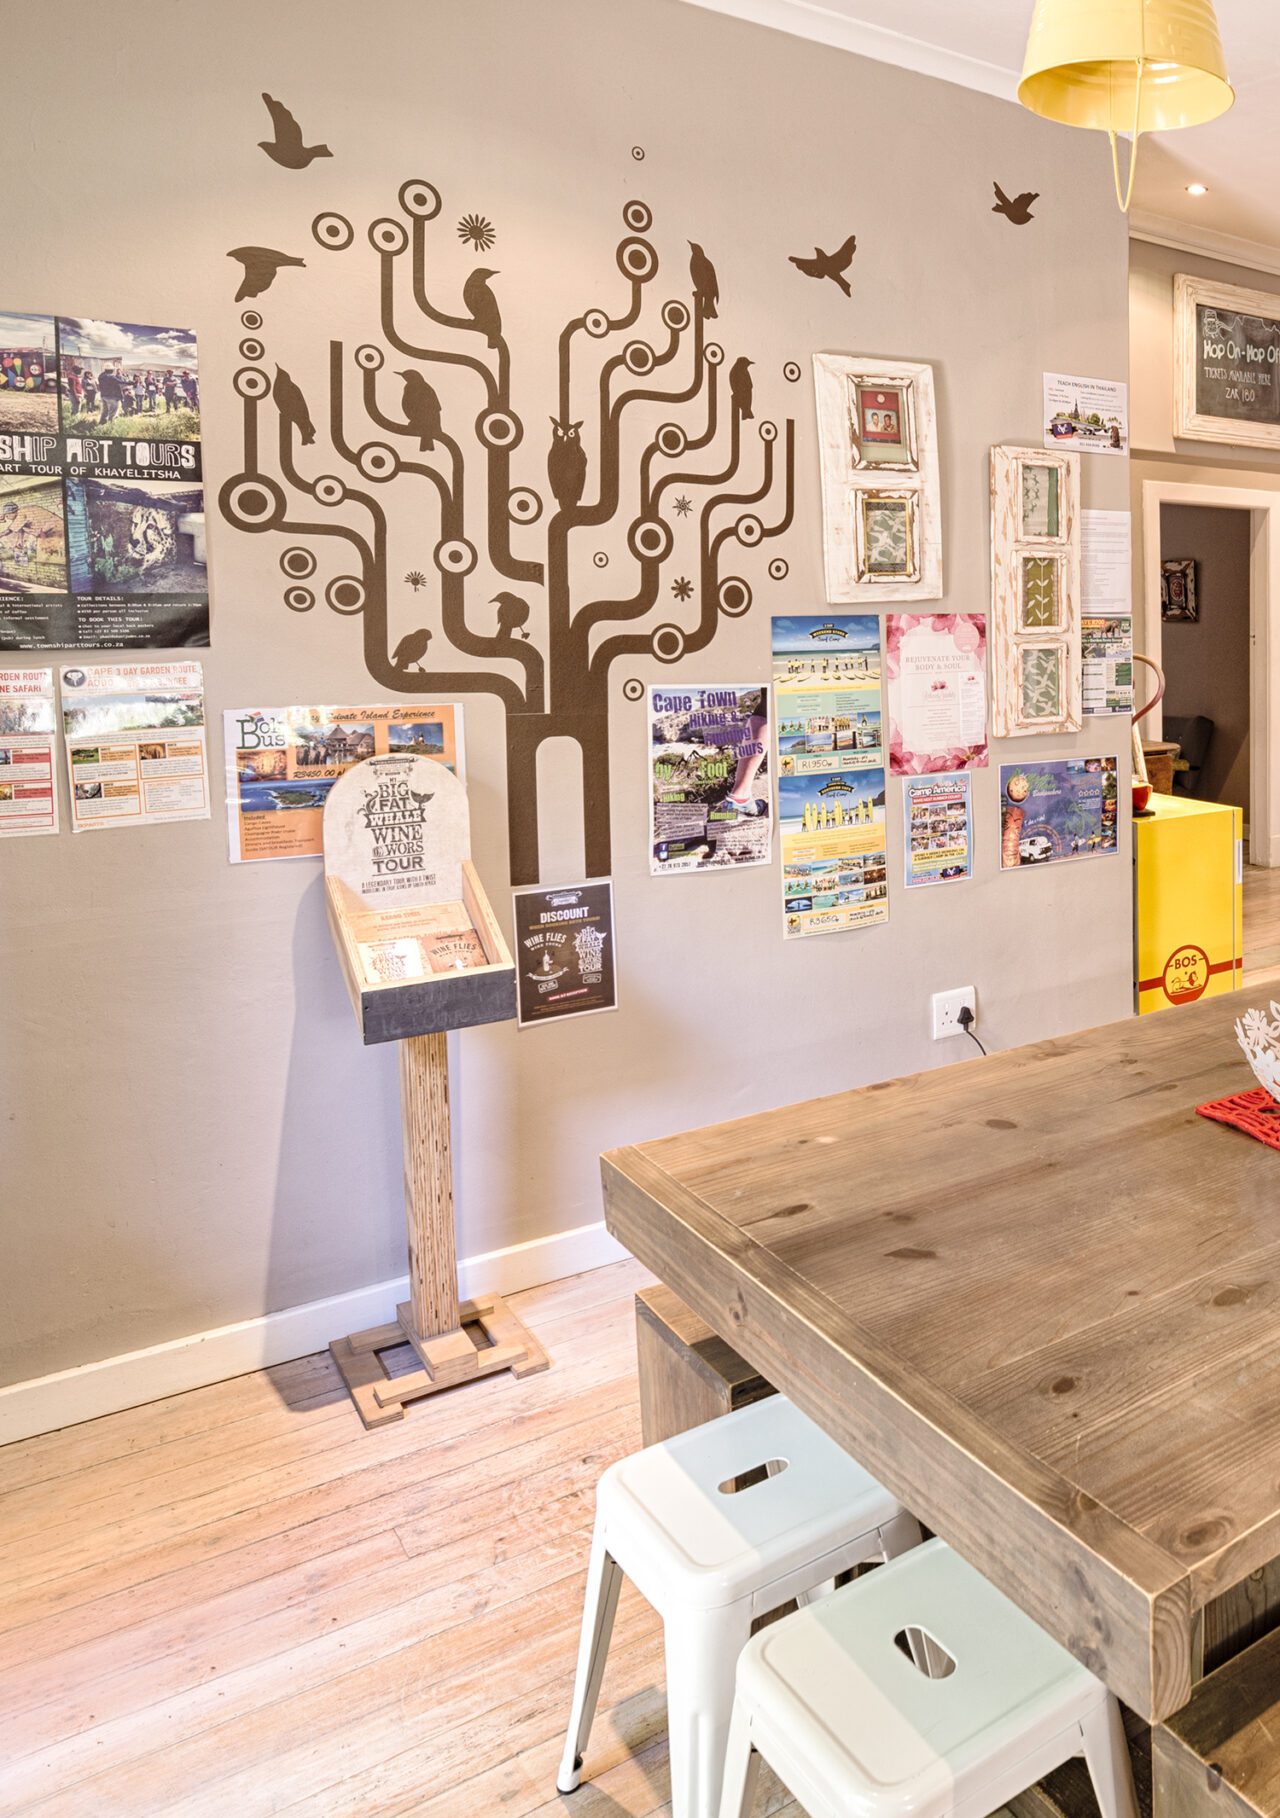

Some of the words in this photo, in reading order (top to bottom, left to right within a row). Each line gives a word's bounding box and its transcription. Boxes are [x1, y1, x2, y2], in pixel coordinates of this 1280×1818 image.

[1204, 340, 1225, 359] Hop
[1204, 367, 1226, 379] TICKETS
[1229, 371, 1255, 384] AVAILABLE
[1258, 374, 1271, 385] HERE
[1226, 388, 1240, 400] ZAR
[1242, 389, 1255, 402] 180
[0, 435, 56, 462] SHIP
[66, 438, 113, 464] ART
[122, 441, 196, 469] TOURS
[0, 463, 22, 473] ART
[30, 464, 62, 474] TOUR
[70, 466, 87, 475] OF
[95, 467, 181, 479] KHAYELITSHA
[653, 693, 692, 713] Cape
[697, 690, 737, 709] Town
[361, 711, 389, 720] Island
[392, 710, 436, 720] Experience
[689, 712, 726, 728] Hiking
[731, 711, 737, 722] &
[732, 742, 764, 759] Tours
[656, 762, 672, 780] by
[378, 782, 410, 798] BIG
[663, 793, 685, 802] Hiking
[909, 788, 932, 797] Camp
[933, 785, 966, 794] America
[379, 797, 409, 811] FAT
[368, 810, 422, 826] WHALE
[371, 824, 423, 844] WINE
[385, 841, 424, 856] WORS
[372, 856, 423, 873] TOUR
[540, 907, 589, 923] DISCOUNT
[524, 933, 544, 948] WINE
[546, 932, 567, 943] FLIES
[431, 944, 450, 956] WINE
[579, 964, 602, 973] TOUR
[1174, 955, 1197, 969] BOS
